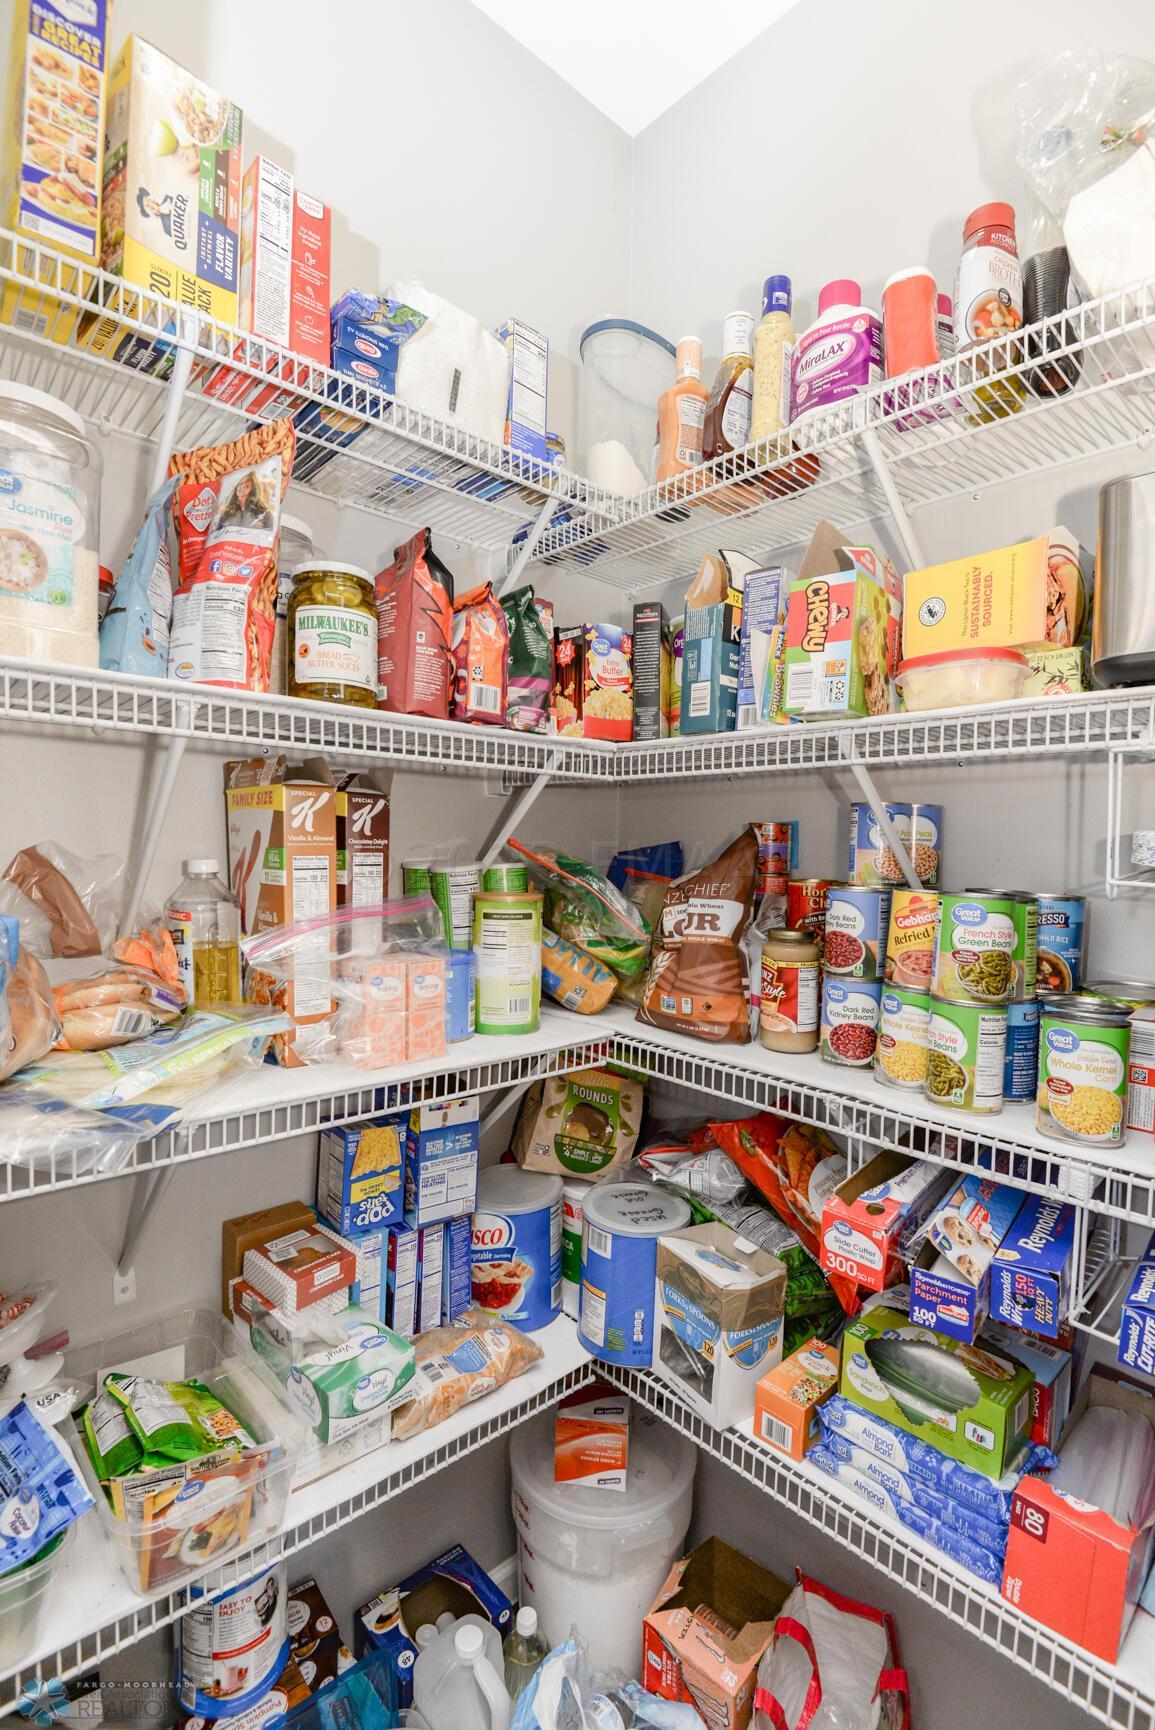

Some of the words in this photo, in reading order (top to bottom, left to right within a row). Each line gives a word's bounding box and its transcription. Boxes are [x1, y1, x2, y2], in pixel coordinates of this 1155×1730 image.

[43, 20, 100, 56] GREAT
[174, 194, 188, 251] QUAKER
[215, 233, 225, 274] FLAVOR
[224, 235, 234, 281] VARIETY
[989, 259, 1021, 288] BROTH
[819, 327, 832, 336] Pour
[832, 322, 850, 333] Bottle
[800, 341, 845, 374] MiraLAX
[343, 369, 354, 377] THIN
[355, 374, 379, 387] SPAGHETTI
[8, 499, 73, 526] Jasmine
[732, 594, 740, 604] 12
[970, 566, 982, 639] SUSTAINABLY
[982, 571, 994, 627] SOURCED.
[299, 616, 369, 637] MILWAUKEE'S
[559, 645, 571, 656] 24
[624, 638, 632, 648] 24
[308, 660, 335, 668] BUTTER
[337, 662, 360, 671] SLICES
[602, 665, 624, 676] Butter
[770, 663, 784, 719] Brownies
[231, 794, 254, 806] FAMILY
[256, 791, 273, 806] SIZE
[291, 792, 330, 832] K
[352, 799, 385, 836] K
[373, 838, 389, 846] Delight
[684, 883, 728, 897] CHIEF
[699, 902, 724, 910] Wheat
[955, 907, 982, 917] Great
[835, 921, 857, 930] Beans
[842, 915, 857, 923] Red
[960, 914, 980, 922] Value
[894, 928, 931, 946] Refried
[958, 936, 989, 947] Green
[991, 939, 1012, 948] Beans
[963, 928, 996, 939] French
[1056, 936, 1069, 944] RICE
[829, 1010, 851, 1021] Kidney
[883, 1018, 904, 1030] Whole
[904, 1023, 929, 1034] Kerne
[938, 1032, 958, 1045] Style
[1048, 1031, 1073, 1045] Great
[1053, 1040, 1073, 1050] Value
[933, 1040, 958, 1054] Beans
[1050, 1057, 1082, 1071] Whole
[1085, 1063, 1118, 1075] Kernel
[1095, 1074, 1118, 1083] Corn
[573, 1084, 614, 1105] ROUNDS
[399, 1131, 407, 1142] 8
[421, 1180, 446, 1189] HEATING
[894, 1168, 917, 1187] Premium
[1017, 1196, 1059, 1254] Reynolds
[833, 1235, 852, 1249] Slide
[853, 1243, 876, 1258] Cutter
[838, 1245, 859, 1258] Plastic
[859, 1253, 876, 1265] Wrap
[293, 1258, 327, 1273] CINNAMON
[826, 1252, 857, 1277] 300
[857, 1271, 867, 1281] SQ
[867, 1277, 876, 1285] FT
[309, 1278, 334, 1294] CINNAMON
[333, 1273, 345, 1281] CAKE
[914, 1270, 943, 1288] Reynolds
[1027, 1276, 1034, 1286] FT
[914, 1279, 968, 1305] Parchment
[914, 1287, 943, 1304] Paper
[999, 1269, 1012, 1319] Reynolds
[938, 1304, 968, 1321] SmartGrid
[1034, 1285, 1045, 1325] HEAVY
[1045, 1296, 1053, 1326] DUTY
[912, 1315, 925, 1326] SQ
[924, 1319, 936, 1329] FT
[913, 1305, 937, 1323] 100
[849, 1324, 869, 1337] 100
[703, 1341, 714, 1356] 120
[769, 1336, 778, 1348] 120
[812, 1338, 826, 1350] 100
[1123, 1318, 1140, 1366] Reynolds
[1136, 1314, 1155, 1375] CUT-RITE
[324, 1344, 352, 1361] Vinyl
[806, 1355, 831, 1372] Snack
[372, 1374, 388, 1389] Vinyl
[850, 1367, 886, 1394] Sandwich
[37, 1392, 61, 1407] USA
[861, 1427, 894, 1450] Almond
[874, 1444, 893, 1460] Bark
[867, 1463, 900, 1487] Almond
[853, 1479, 885, 1506] Almond
[1024, 1507, 1045, 1536] 80
[1012, 1577, 1023, 1604] Double
[219, 1601, 238, 1611] EASY
[239, 1596, 252, 1605] TO
[219, 1605, 246, 1618] ENJOY
[318, 1619, 329, 1628] 12
[401, 1656, 412, 1666] 48
[246, 1700, 282, 1727] Pumpkin
